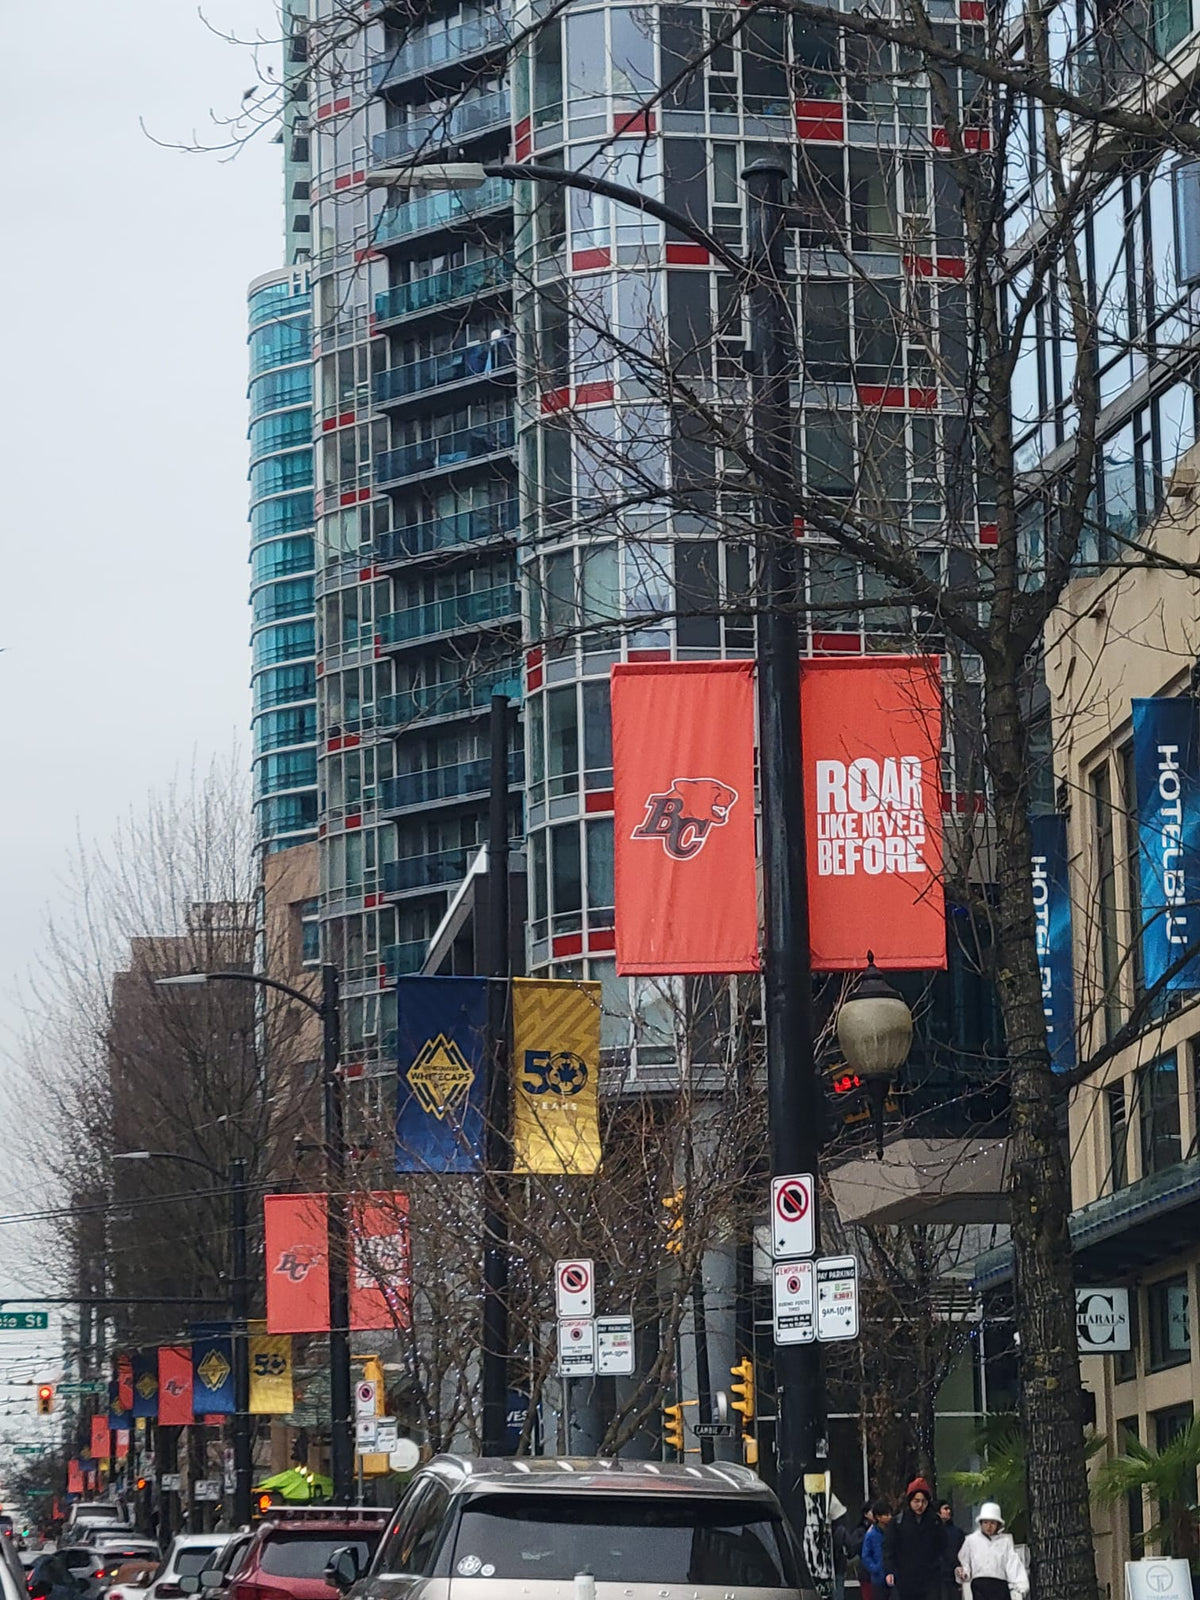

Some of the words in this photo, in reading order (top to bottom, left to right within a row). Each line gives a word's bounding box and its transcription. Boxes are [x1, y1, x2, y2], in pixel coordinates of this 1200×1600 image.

[816, 755, 923, 813] ROAR
[817, 813, 858, 838] LIKE
[862, 809, 925, 838] NEVER
[817, 836, 926, 876] BEFORE
[776, 1264, 811, 1277] TEMPORARY
[818, 1271, 828, 1280] PAY
[829, 1269, 855, 1279] PARKING
[25, 1314, 43, 1328] St
[521, 1586, 736, 1600] LICOLN
